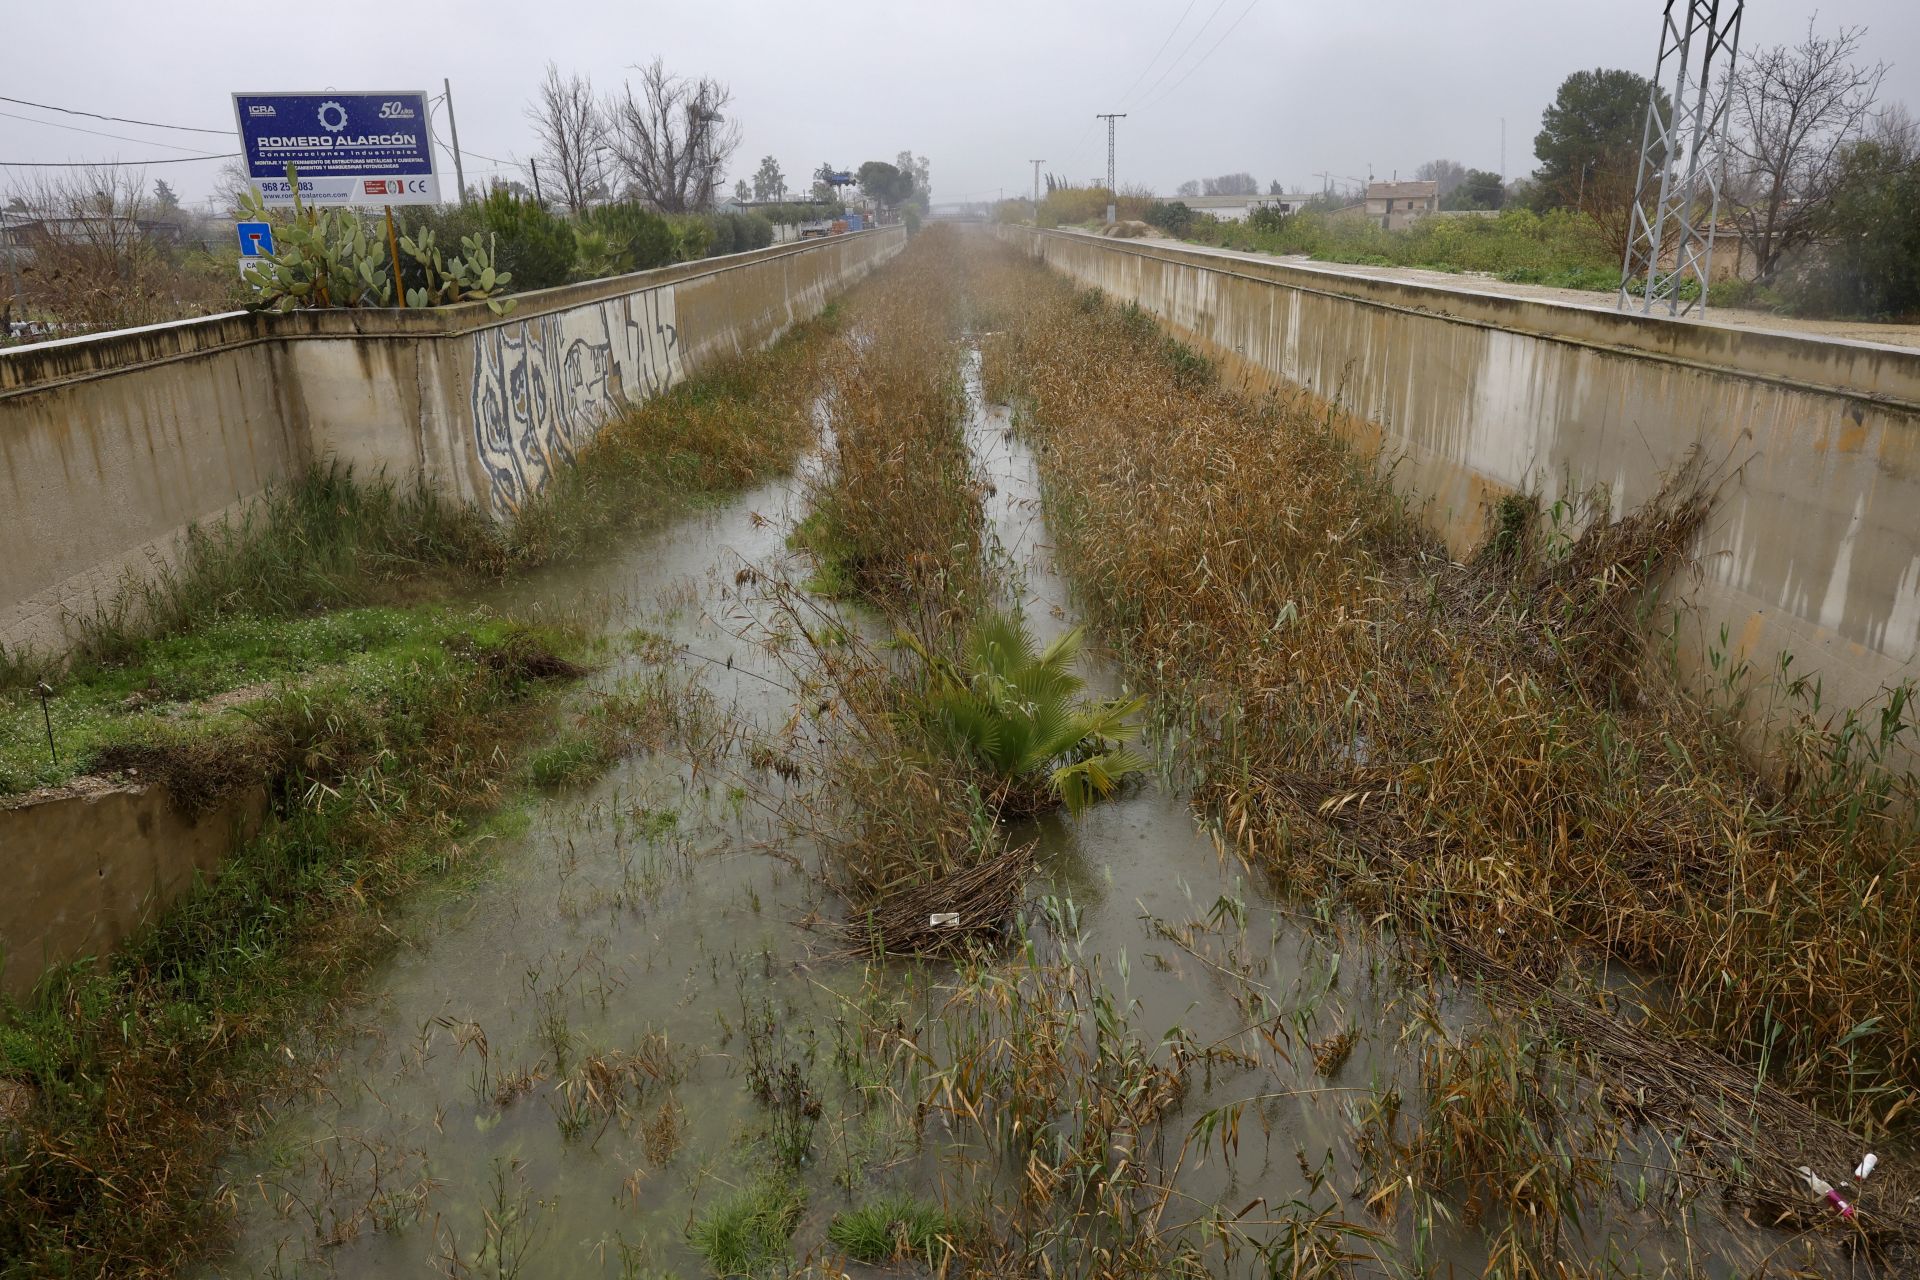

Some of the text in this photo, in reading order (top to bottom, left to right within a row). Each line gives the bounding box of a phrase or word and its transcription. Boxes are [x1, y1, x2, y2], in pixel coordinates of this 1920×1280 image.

[249, 105, 276, 113] ICRA
[379, 102, 402, 118] 50
[257, 132, 417, 146] ROMERO ALARCÓN
[262, 182, 278, 192] 968
[297, 181, 314, 191] 083
